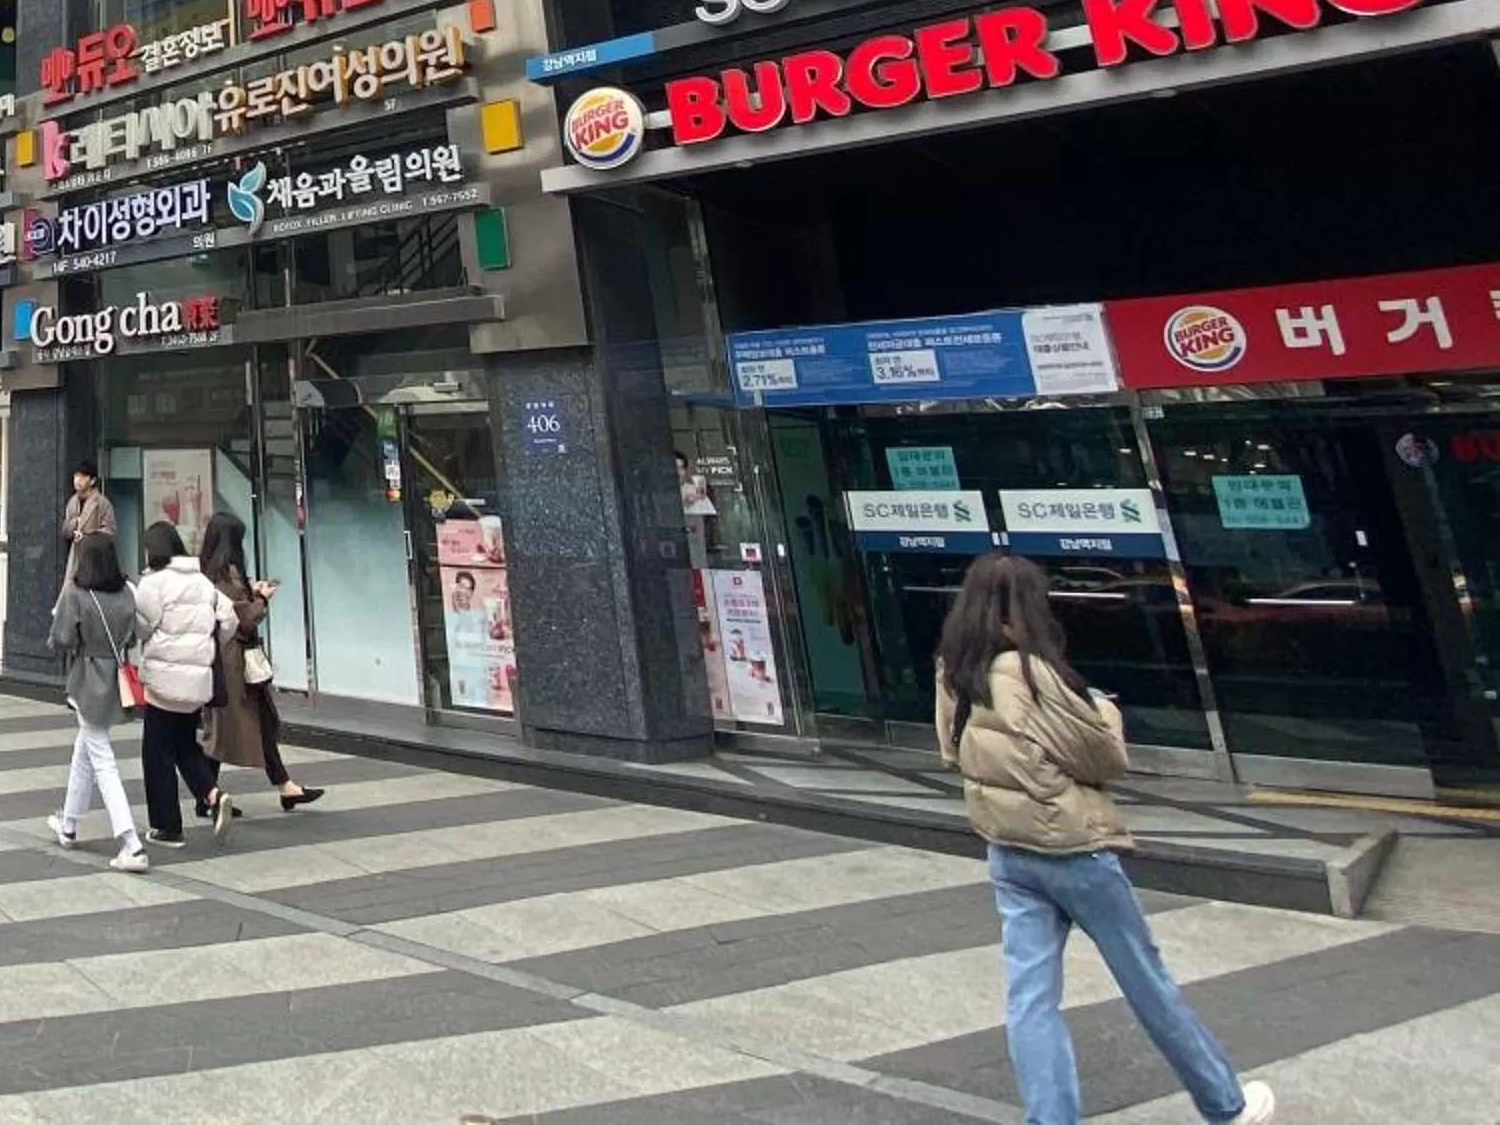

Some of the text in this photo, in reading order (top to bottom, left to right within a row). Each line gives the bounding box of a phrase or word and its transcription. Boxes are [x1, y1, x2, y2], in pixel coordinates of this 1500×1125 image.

[77, 21, 226, 92] 듀오 결혼정보
[214, 26, 464, 132] 유로진여성의원
[665, 6, 1061, 146] BURGER
[572, 96, 627, 129] BURGER
[574, 107, 630, 151] KING
[57, 177, 211, 249] 차이성형외과
[30, 291, 182, 354] Gong cha
[1174, 316, 1229, 342] BURGER
[1178, 326, 1235, 357] KING
[1275, 290, 1500, 356] 버거
[527, 413, 561, 433] 406
[1017, 502, 1115, 520] SC제일은행
